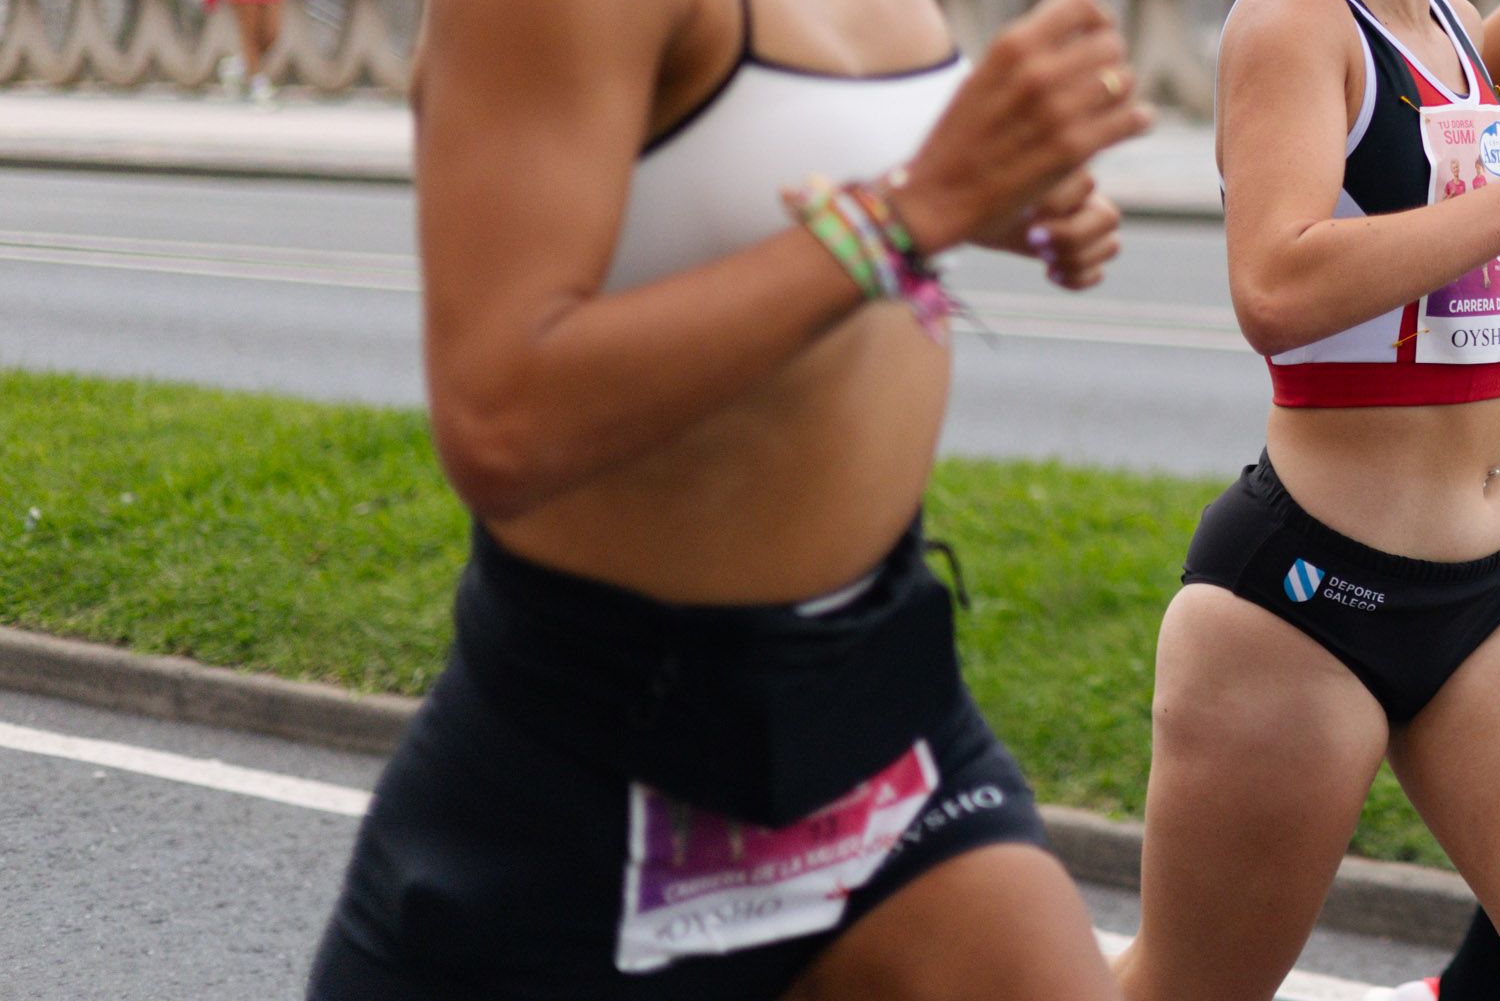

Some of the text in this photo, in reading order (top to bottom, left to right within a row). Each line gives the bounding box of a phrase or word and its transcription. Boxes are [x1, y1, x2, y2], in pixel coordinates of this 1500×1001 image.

[1438, 119, 1474, 129] TU DORSA
[1443, 129, 1477, 145] SUMA
[1448, 297, 1495, 313] CARRERA
[1328, 576, 1386, 603] DEPORTE
[1323, 588, 1377, 612] GALEGO
[895, 786, 1003, 852] YSHO
